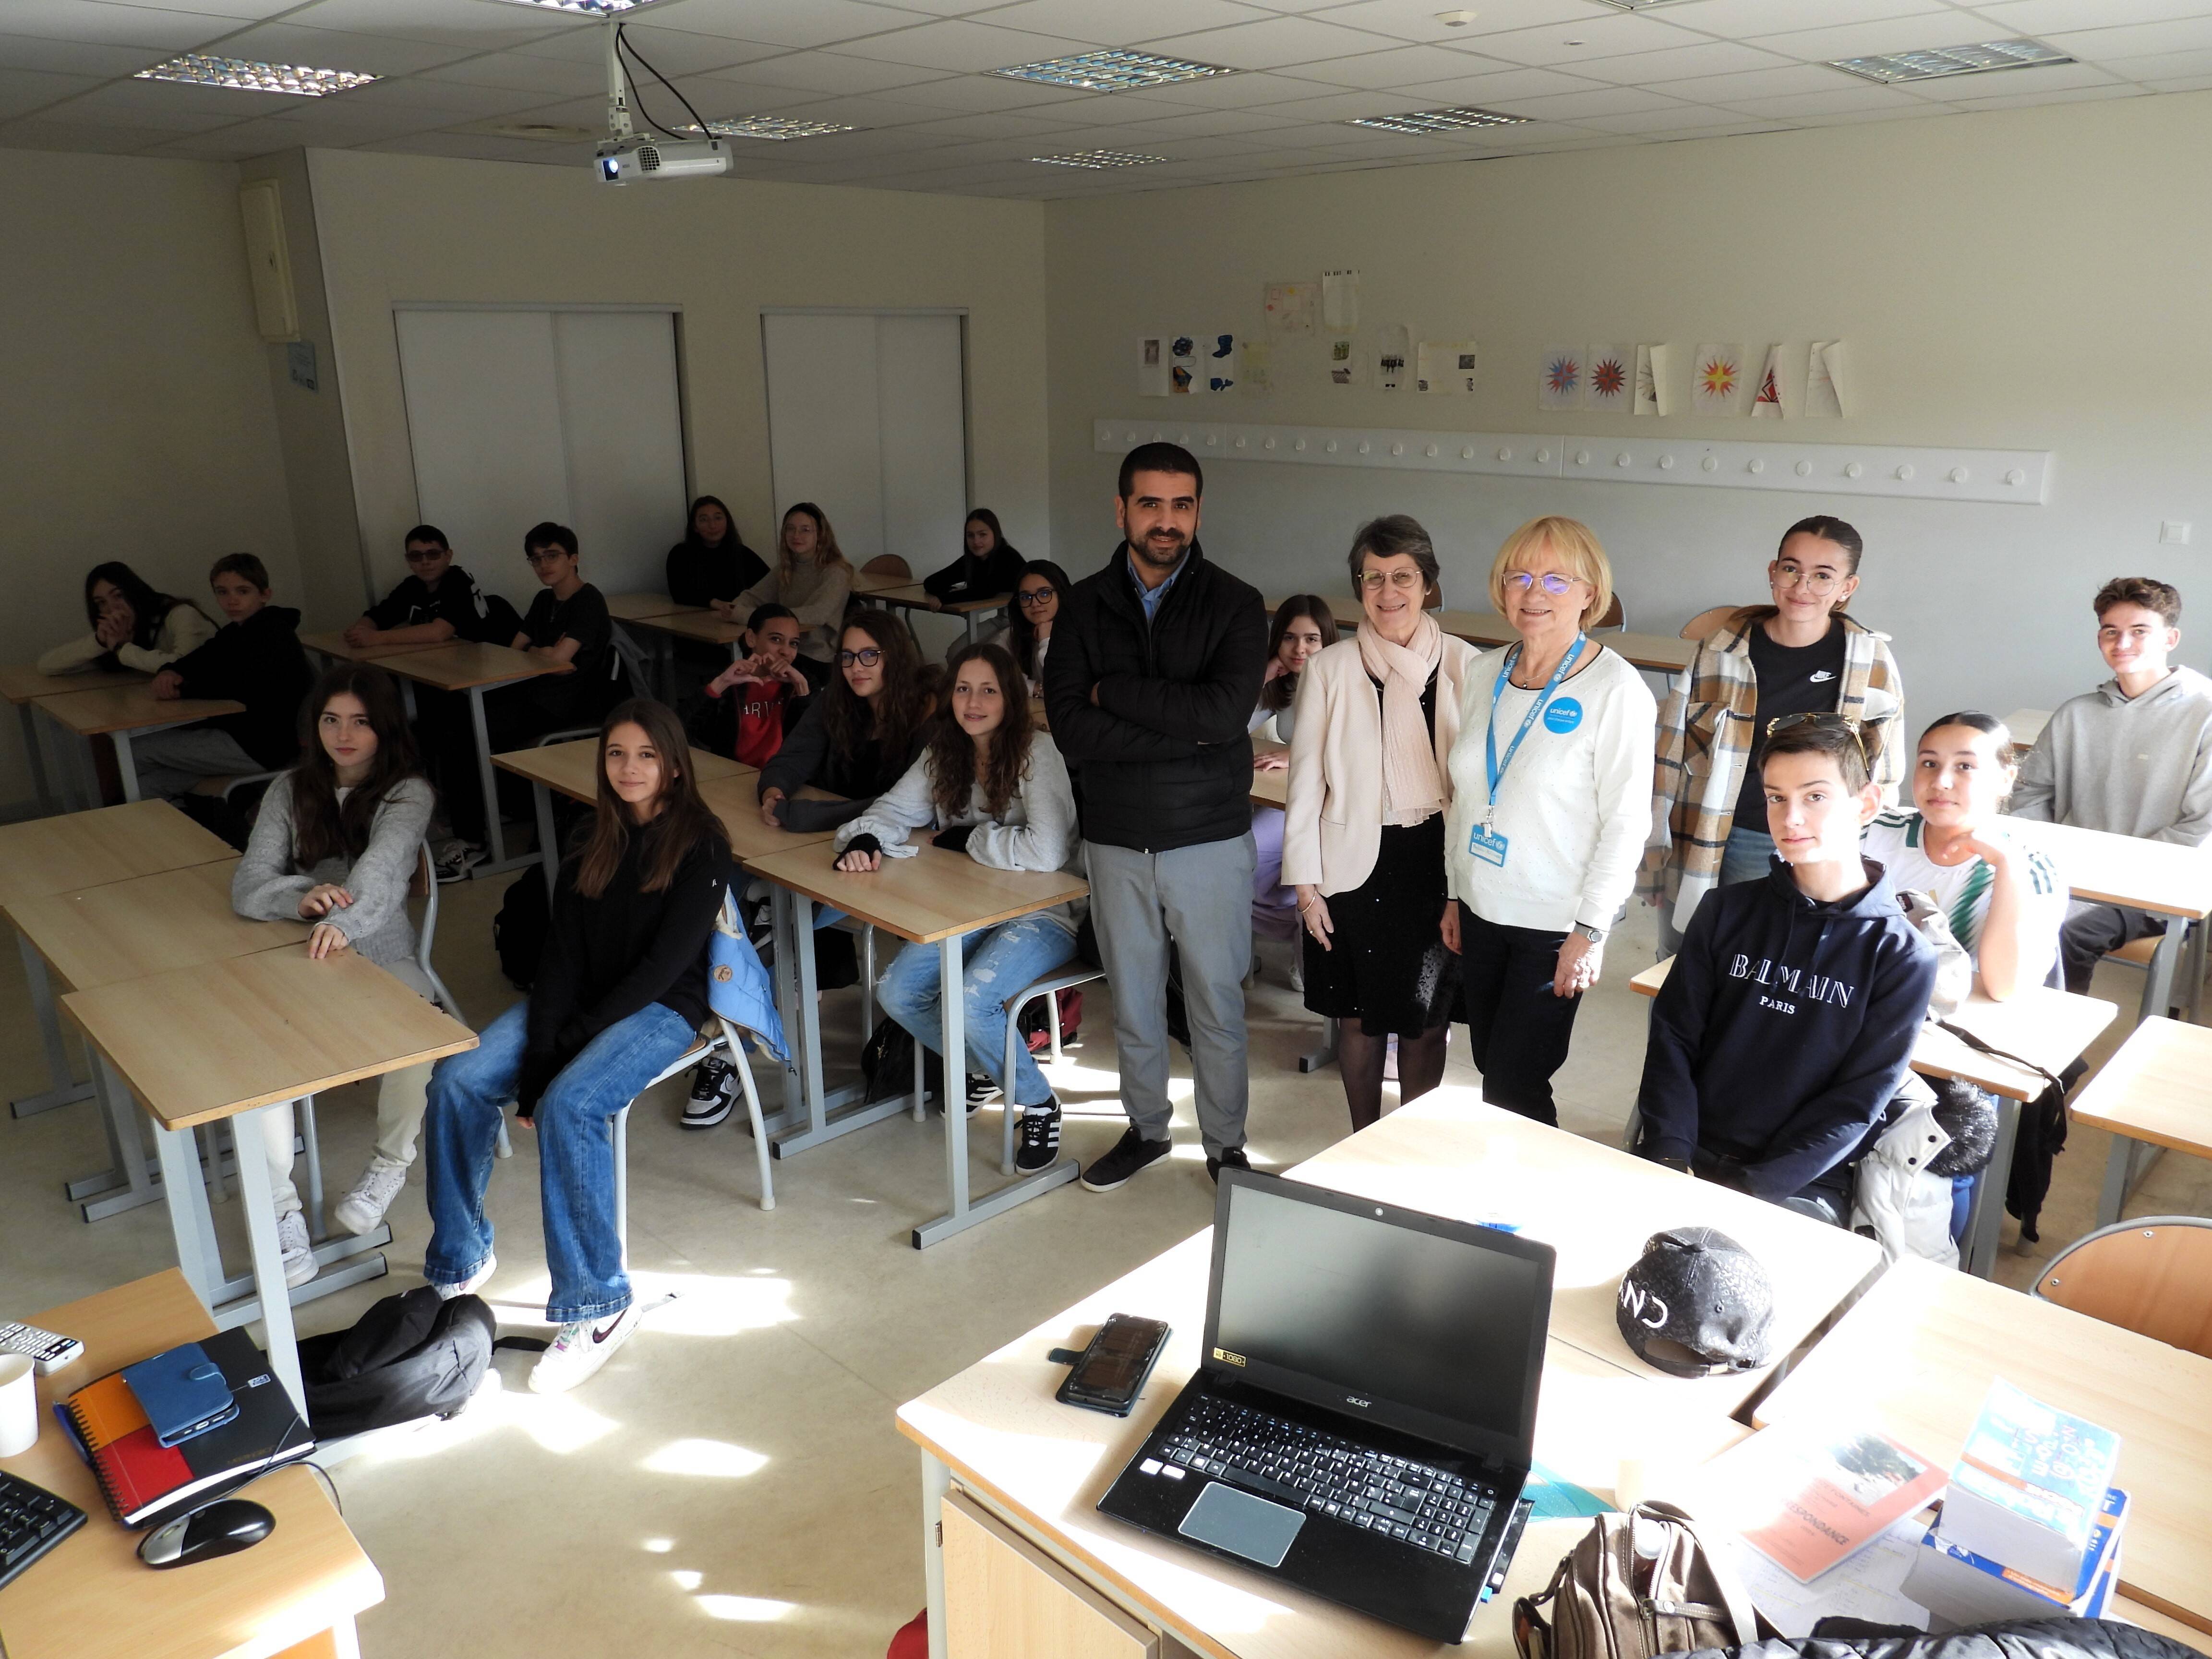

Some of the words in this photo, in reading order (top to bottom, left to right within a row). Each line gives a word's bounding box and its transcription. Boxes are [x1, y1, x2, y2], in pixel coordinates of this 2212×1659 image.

[1502, 660, 1515, 677] unicef
[1559, 654, 1575, 675] unicef
[1528, 699, 1543, 720] unicef
[1473, 832, 1496, 847] unicef
[1729, 953, 1854, 1008] BALMAIN
[1759, 996, 1795, 1014] PARIS
[1346, 1395, 1372, 1408] acer
